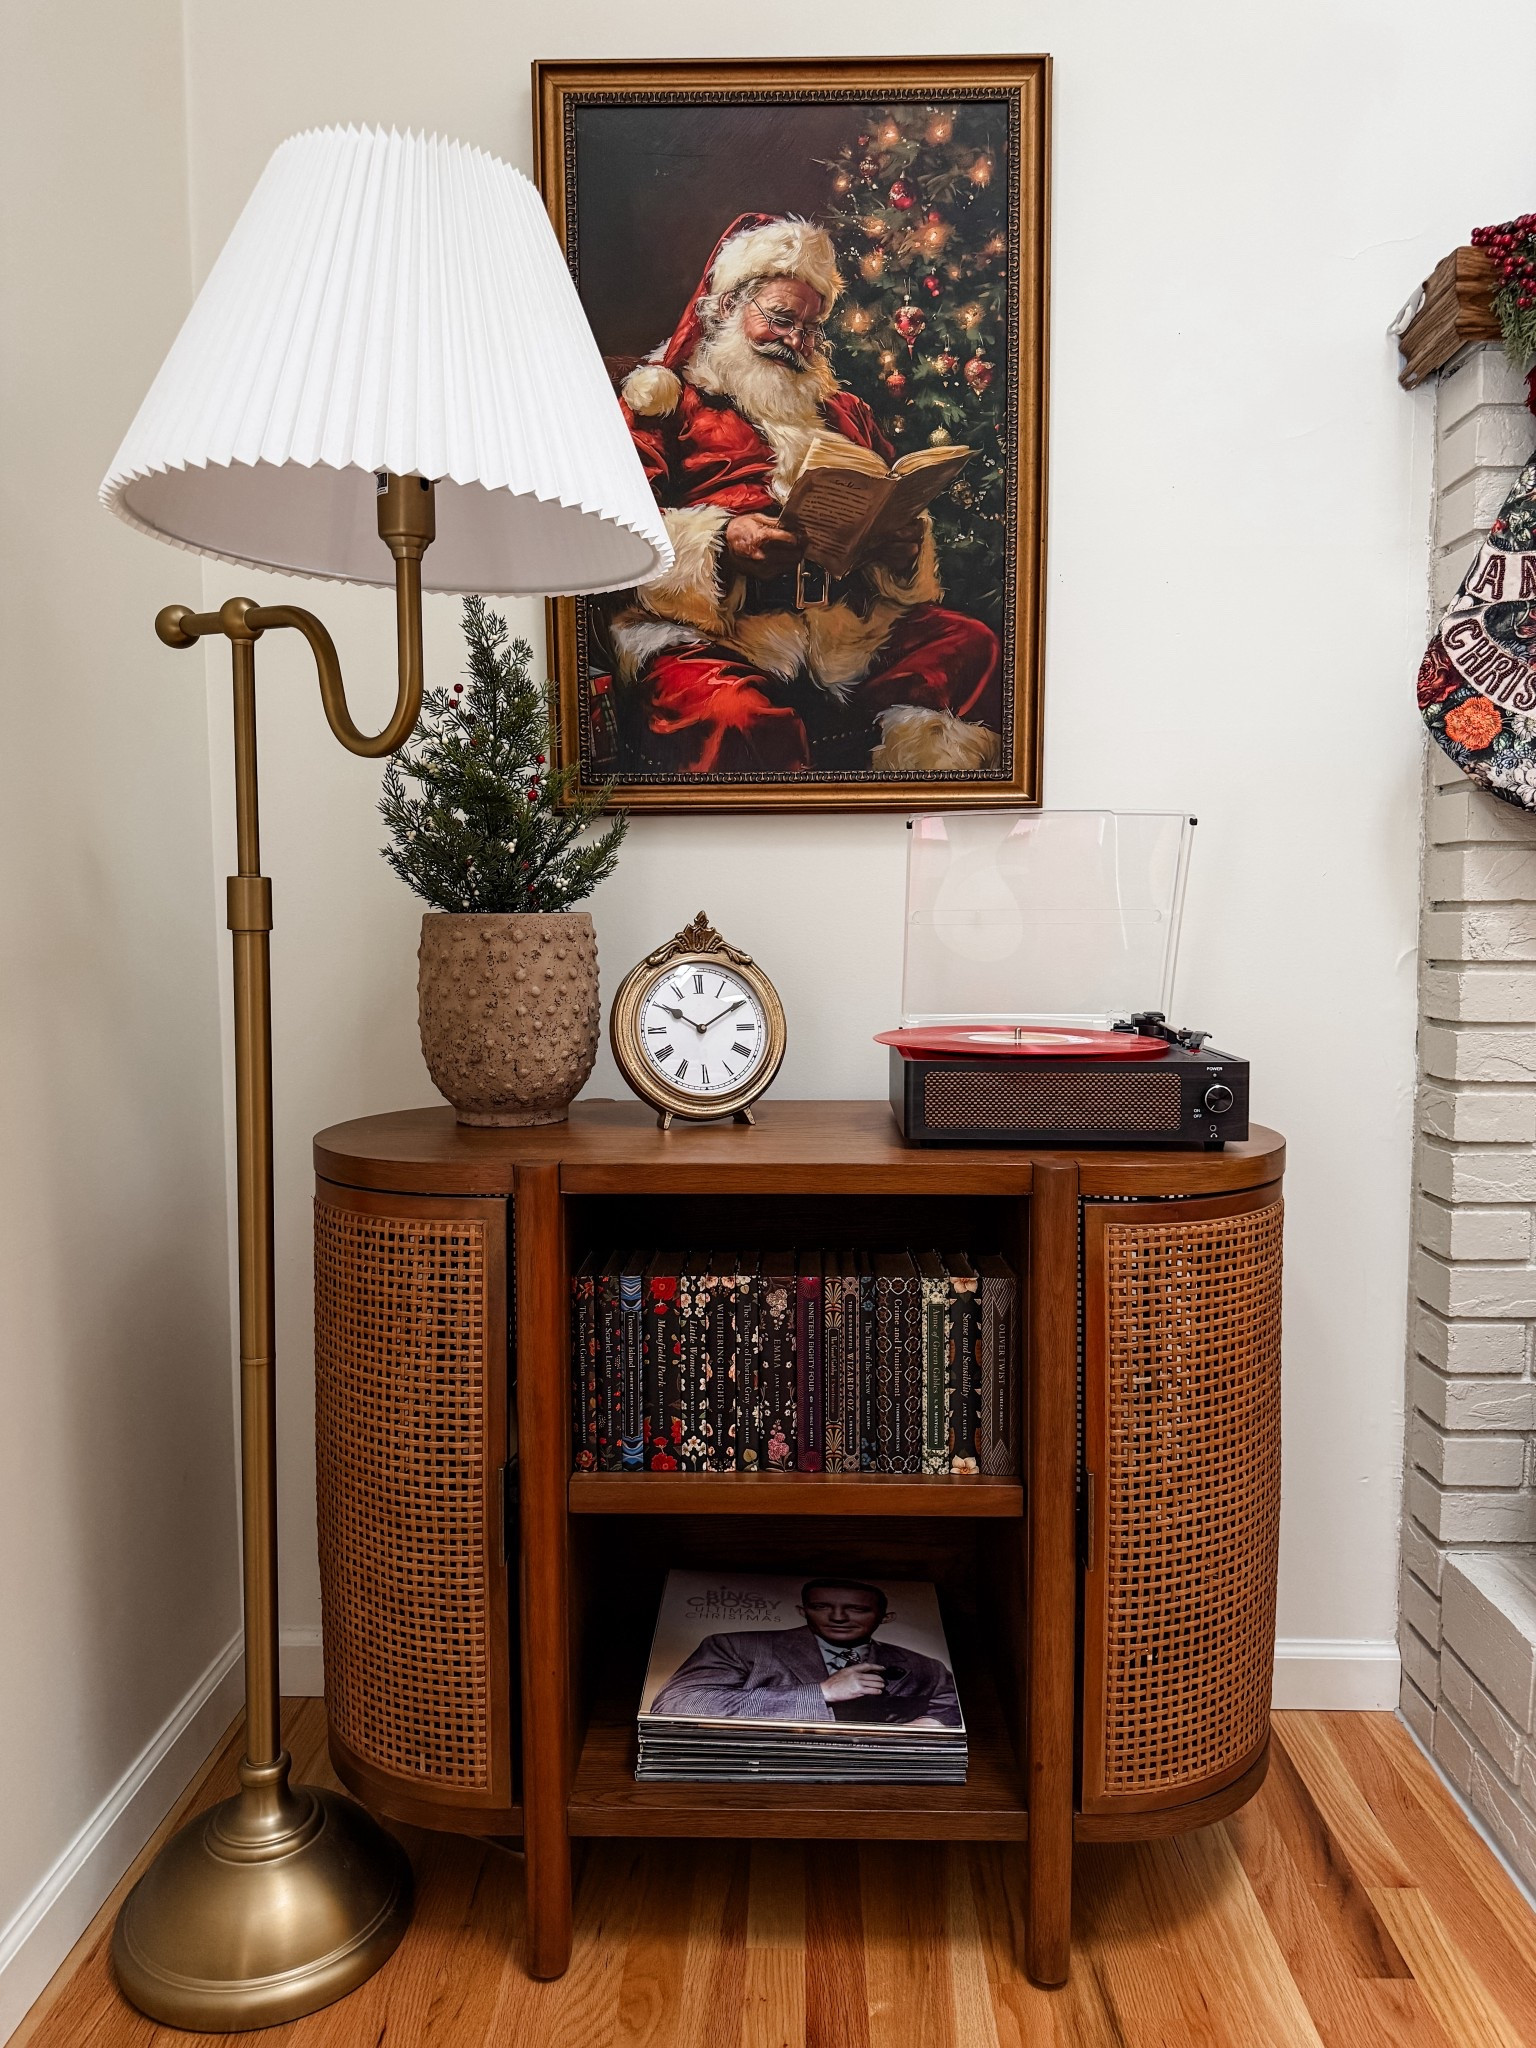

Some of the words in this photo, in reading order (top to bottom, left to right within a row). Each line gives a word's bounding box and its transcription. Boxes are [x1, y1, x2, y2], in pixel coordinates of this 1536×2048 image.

[579, 1305, 587, 1320] The
[894, 1298, 902, 1325] Crime
[932, 1307, 940, 1329] Anne
[579, 1322, 587, 1346] Secret
[690, 1320, 698, 1343] Little
[962, 1312, 971, 1335] Sense
[656, 1318, 666, 1362] Mansfield
[894, 1327, 902, 1343] and
[962, 1338, 971, 1353] and
[690, 1347, 698, 1378] Women
[744, 1348, 751, 1356] of
[932, 1341, 940, 1364] Green
[657, 1366, 666, 1387] Park
[894, 1346, 902, 1398] Punishment
[932, 1367, 940, 1395] Gables
[961, 1356, 971, 1399] Sensibility
[742, 1386, 751, 1406] Gray
[847, 1398, 854, 1412] OZ
[686, 1596, 782, 1609] CROSBY
[706, 1587, 764, 1602] BING
[685, 1612, 782, 1622] CHRISTMAS
[695, 1606, 773, 1616] ULTIMATE
